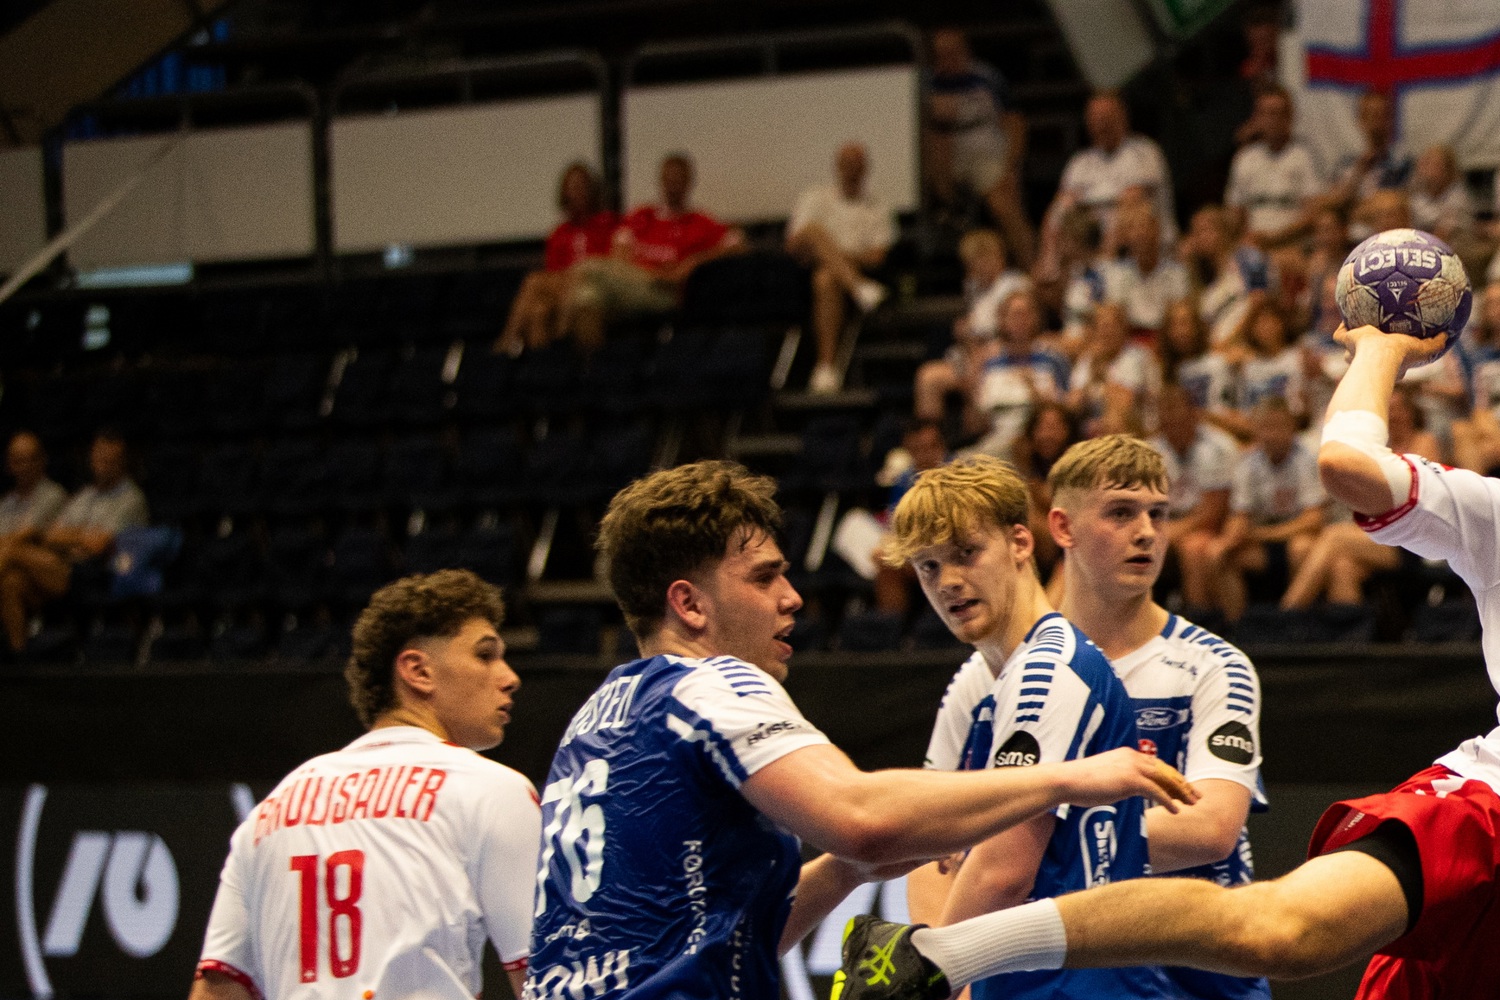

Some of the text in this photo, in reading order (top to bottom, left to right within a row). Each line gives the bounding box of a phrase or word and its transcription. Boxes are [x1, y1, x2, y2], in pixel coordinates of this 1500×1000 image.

[1359, 248, 1437, 277] SELECT
[1136, 709, 1173, 727] Ford
[1211, 734, 1254, 753] sms
[995, 750, 1037, 767] sms
[536, 758, 609, 917] 76
[290, 849, 366, 984] 18
